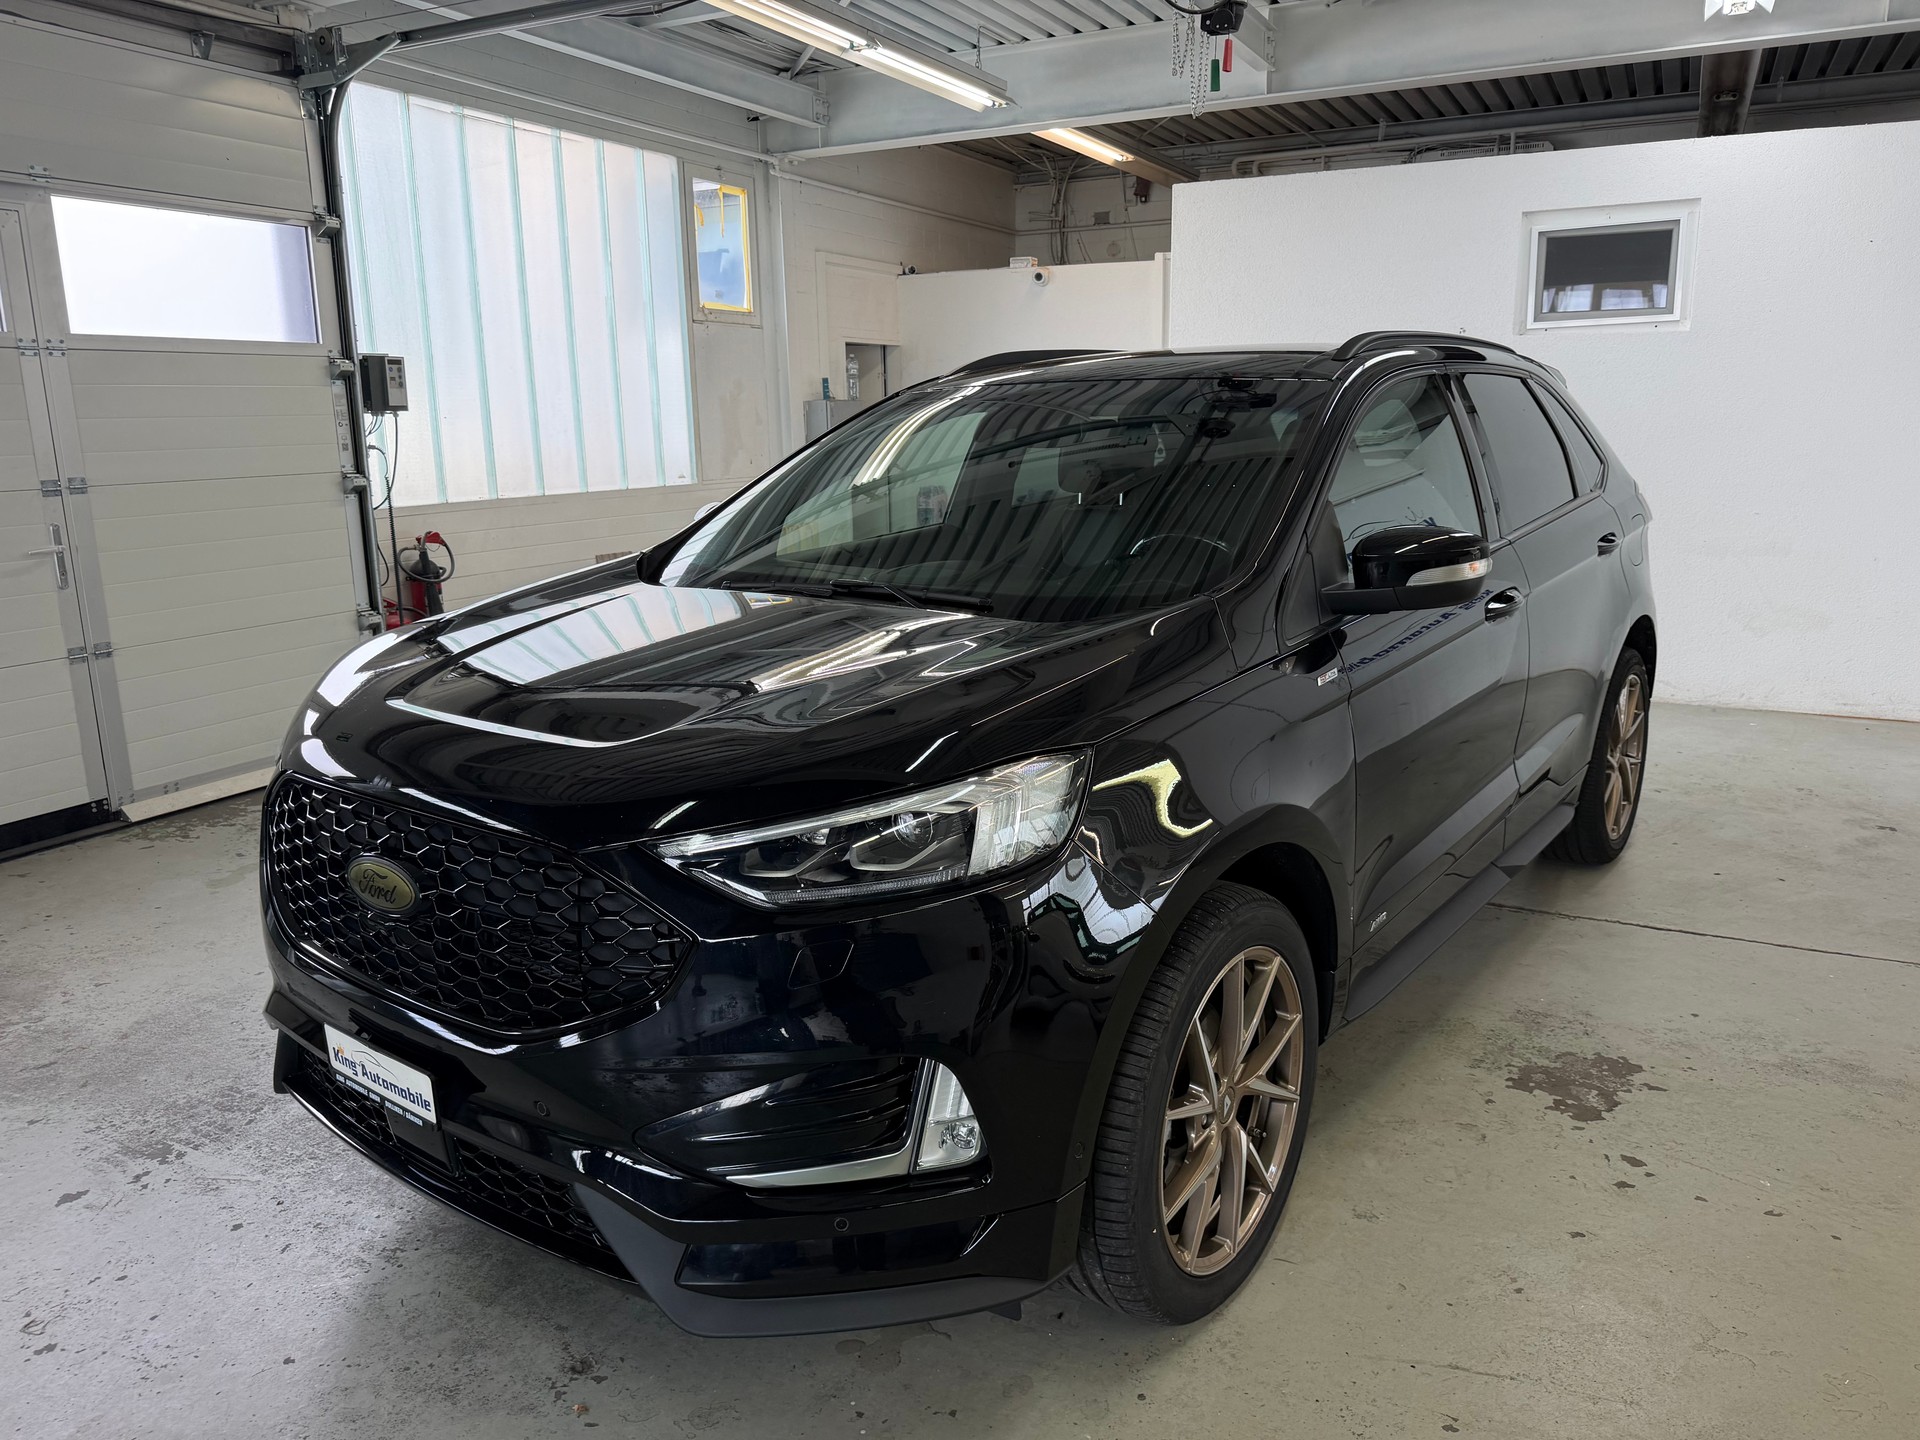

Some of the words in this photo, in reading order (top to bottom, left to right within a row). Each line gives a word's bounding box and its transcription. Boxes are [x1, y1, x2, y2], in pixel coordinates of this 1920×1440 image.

[359, 869, 398, 904] Ford
[332, 1046, 359, 1077] King
[361, 1063, 432, 1113] Automobile
